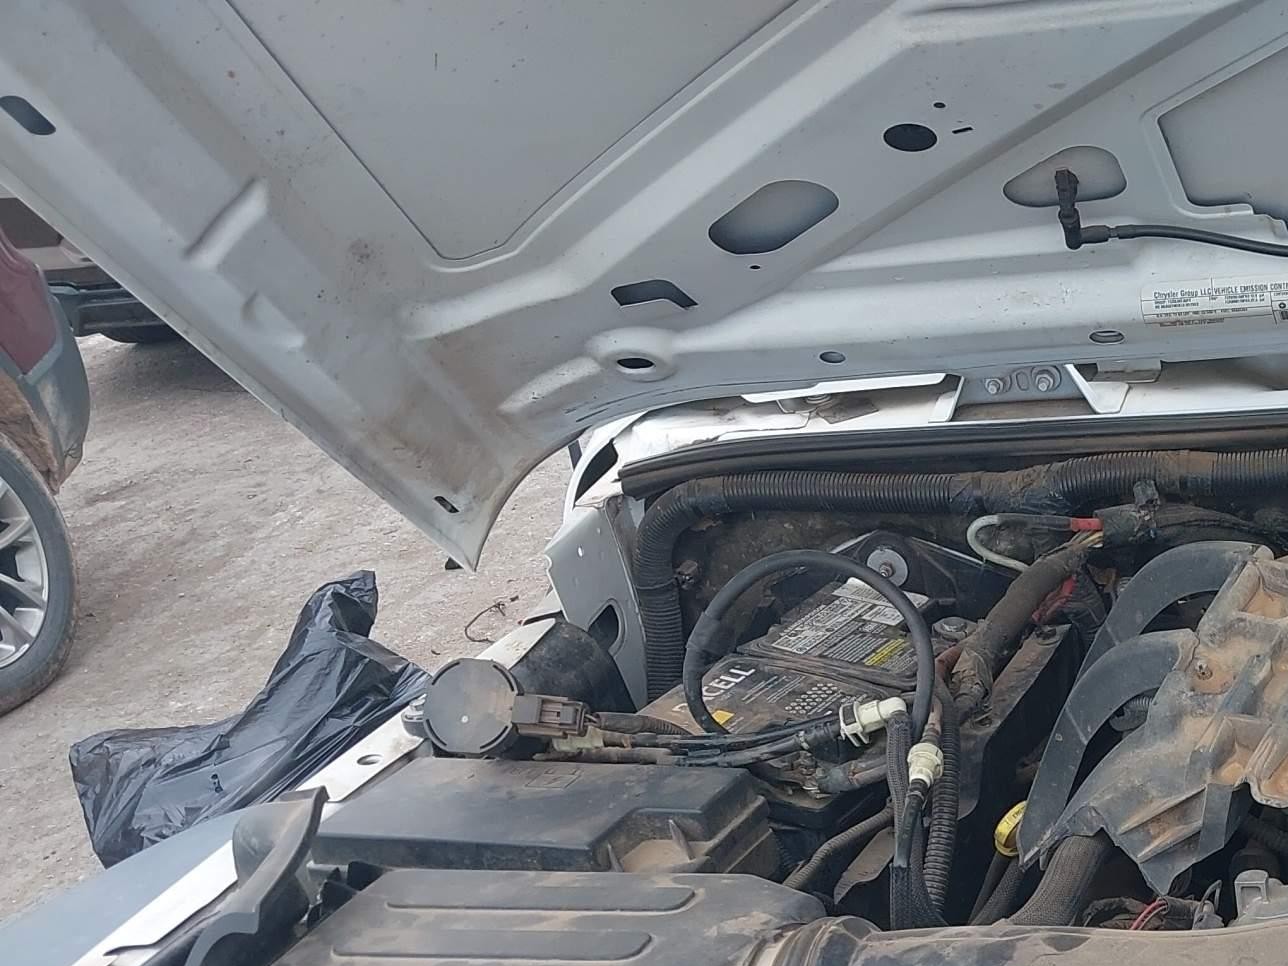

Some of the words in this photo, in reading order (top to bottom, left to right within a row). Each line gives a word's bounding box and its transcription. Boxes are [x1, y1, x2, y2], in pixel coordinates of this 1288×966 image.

[1153, 290, 1179, 300] Chrysler
[1180, 289, 1198, 298] Group
[1200, 288, 1211, 296] LLC
[1213, 285, 1238, 295] VEHICLE
[1239, 284, 1268, 293] EMISSION
